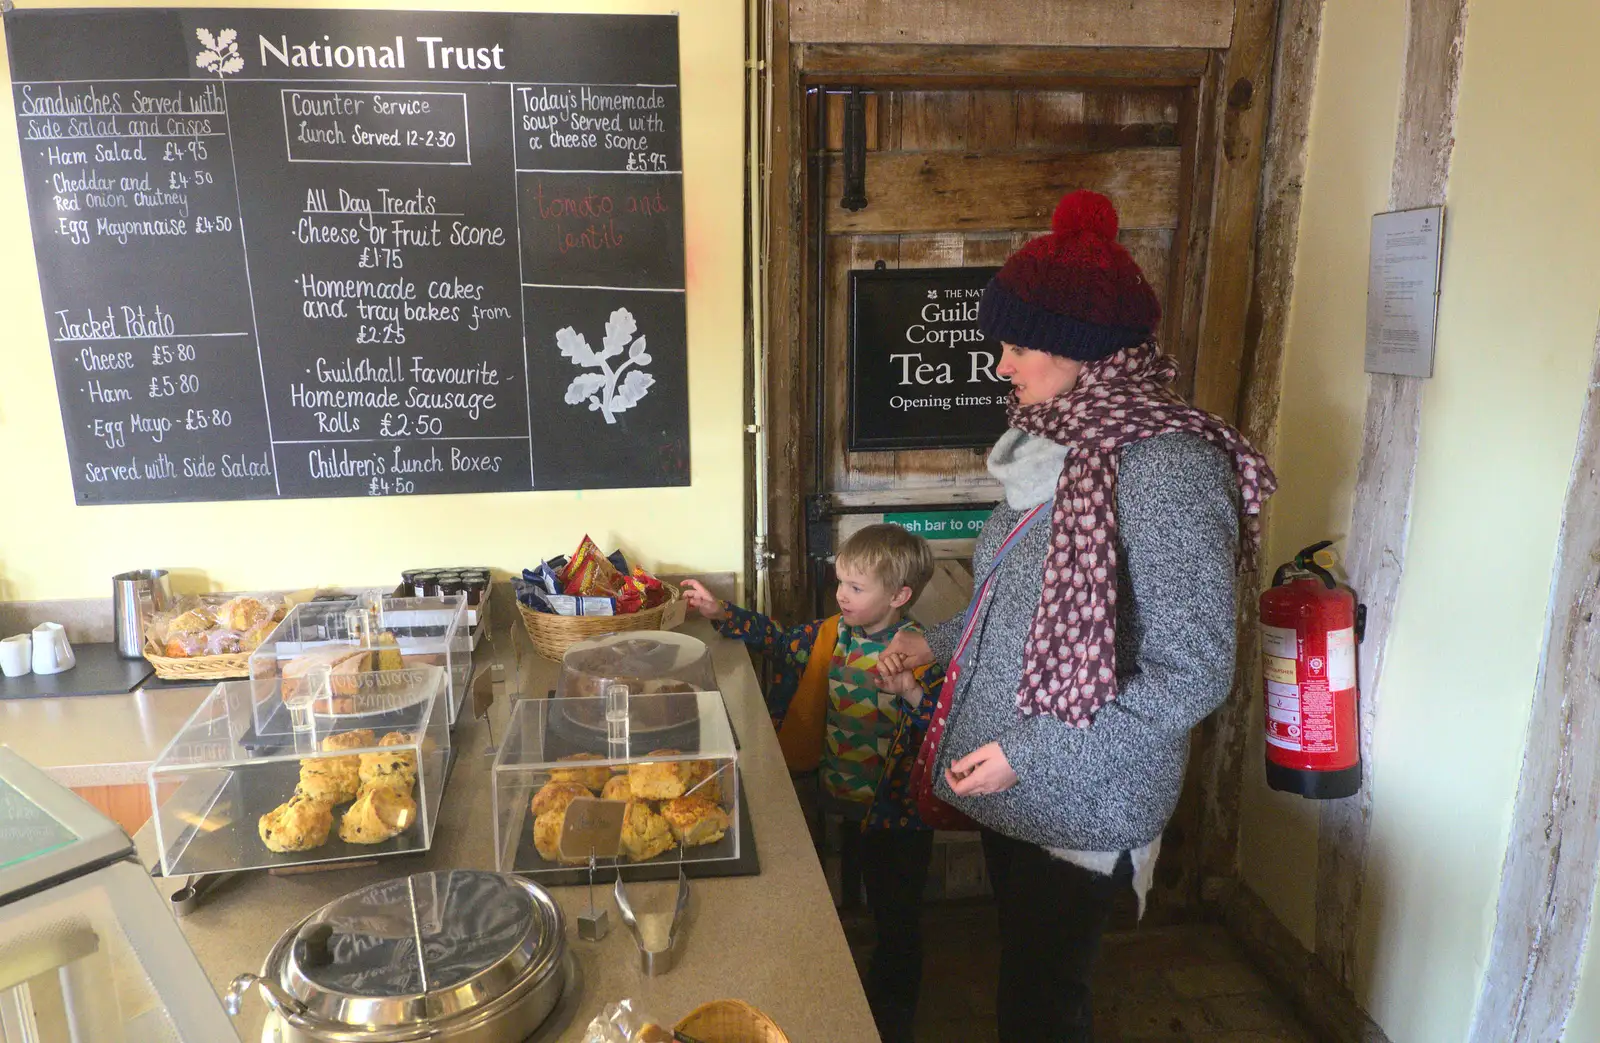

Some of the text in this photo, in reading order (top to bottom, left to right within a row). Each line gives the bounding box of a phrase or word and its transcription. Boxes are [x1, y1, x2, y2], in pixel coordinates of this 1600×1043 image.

[259, 34, 506, 70] National Trust
[22, 84, 122, 114] Sandwiches
[189, 83, 225, 113] with
[292, 93, 431, 116] Counter Service
[517, 86, 665, 122] Today's Homemade
[68, 115, 119, 136] Salad
[128, 116, 163, 135] and
[298, 121, 346, 144] Lunch
[352, 124, 402, 146] Served
[629, 112, 665, 132] with
[48, 147, 87, 165] Ham
[95, 140, 146, 162] Salad
[529, 136, 543, 150] a
[53, 168, 116, 193] Cheddar
[120, 171, 152, 191] and
[53, 193, 81, 211] Red
[306, 188, 436, 232] All Day Treats
[535, 182, 669, 219] tomato and
[58, 217, 90, 244] Egg
[97, 217, 187, 245] Mayonnaise
[298, 216, 506, 248] Cheese or Fruit Scone
[557, 219, 623, 254] lentil
[302, 273, 417, 299] Homemade
[944, 289, 962, 298] THE
[55, 305, 175, 339] Jacket Potato
[303, 299, 511, 331] and tray bakes from
[906, 325, 985, 348] Corpus
[80, 347, 134, 371] Cheese
[316, 356, 404, 384] Guildhall
[410, 356, 500, 385] Favourite
[889, 352, 954, 385] Tea
[88, 380, 132, 403] Ham
[291, 383, 497, 420] Homemade Sausage
[889, 395, 951, 412] Opening
[955, 393, 992, 406] times
[94, 419, 125, 449] Egg
[131, 413, 172, 443] Mayo
[314, 411, 360, 433] Rolls
[145, 453, 178, 480] with
[221, 452, 272, 478] Salad
[309, 446, 502, 479] Children's Lunch Boxes
[925, 519, 947, 531] bar
[950, 519, 963, 530] to
